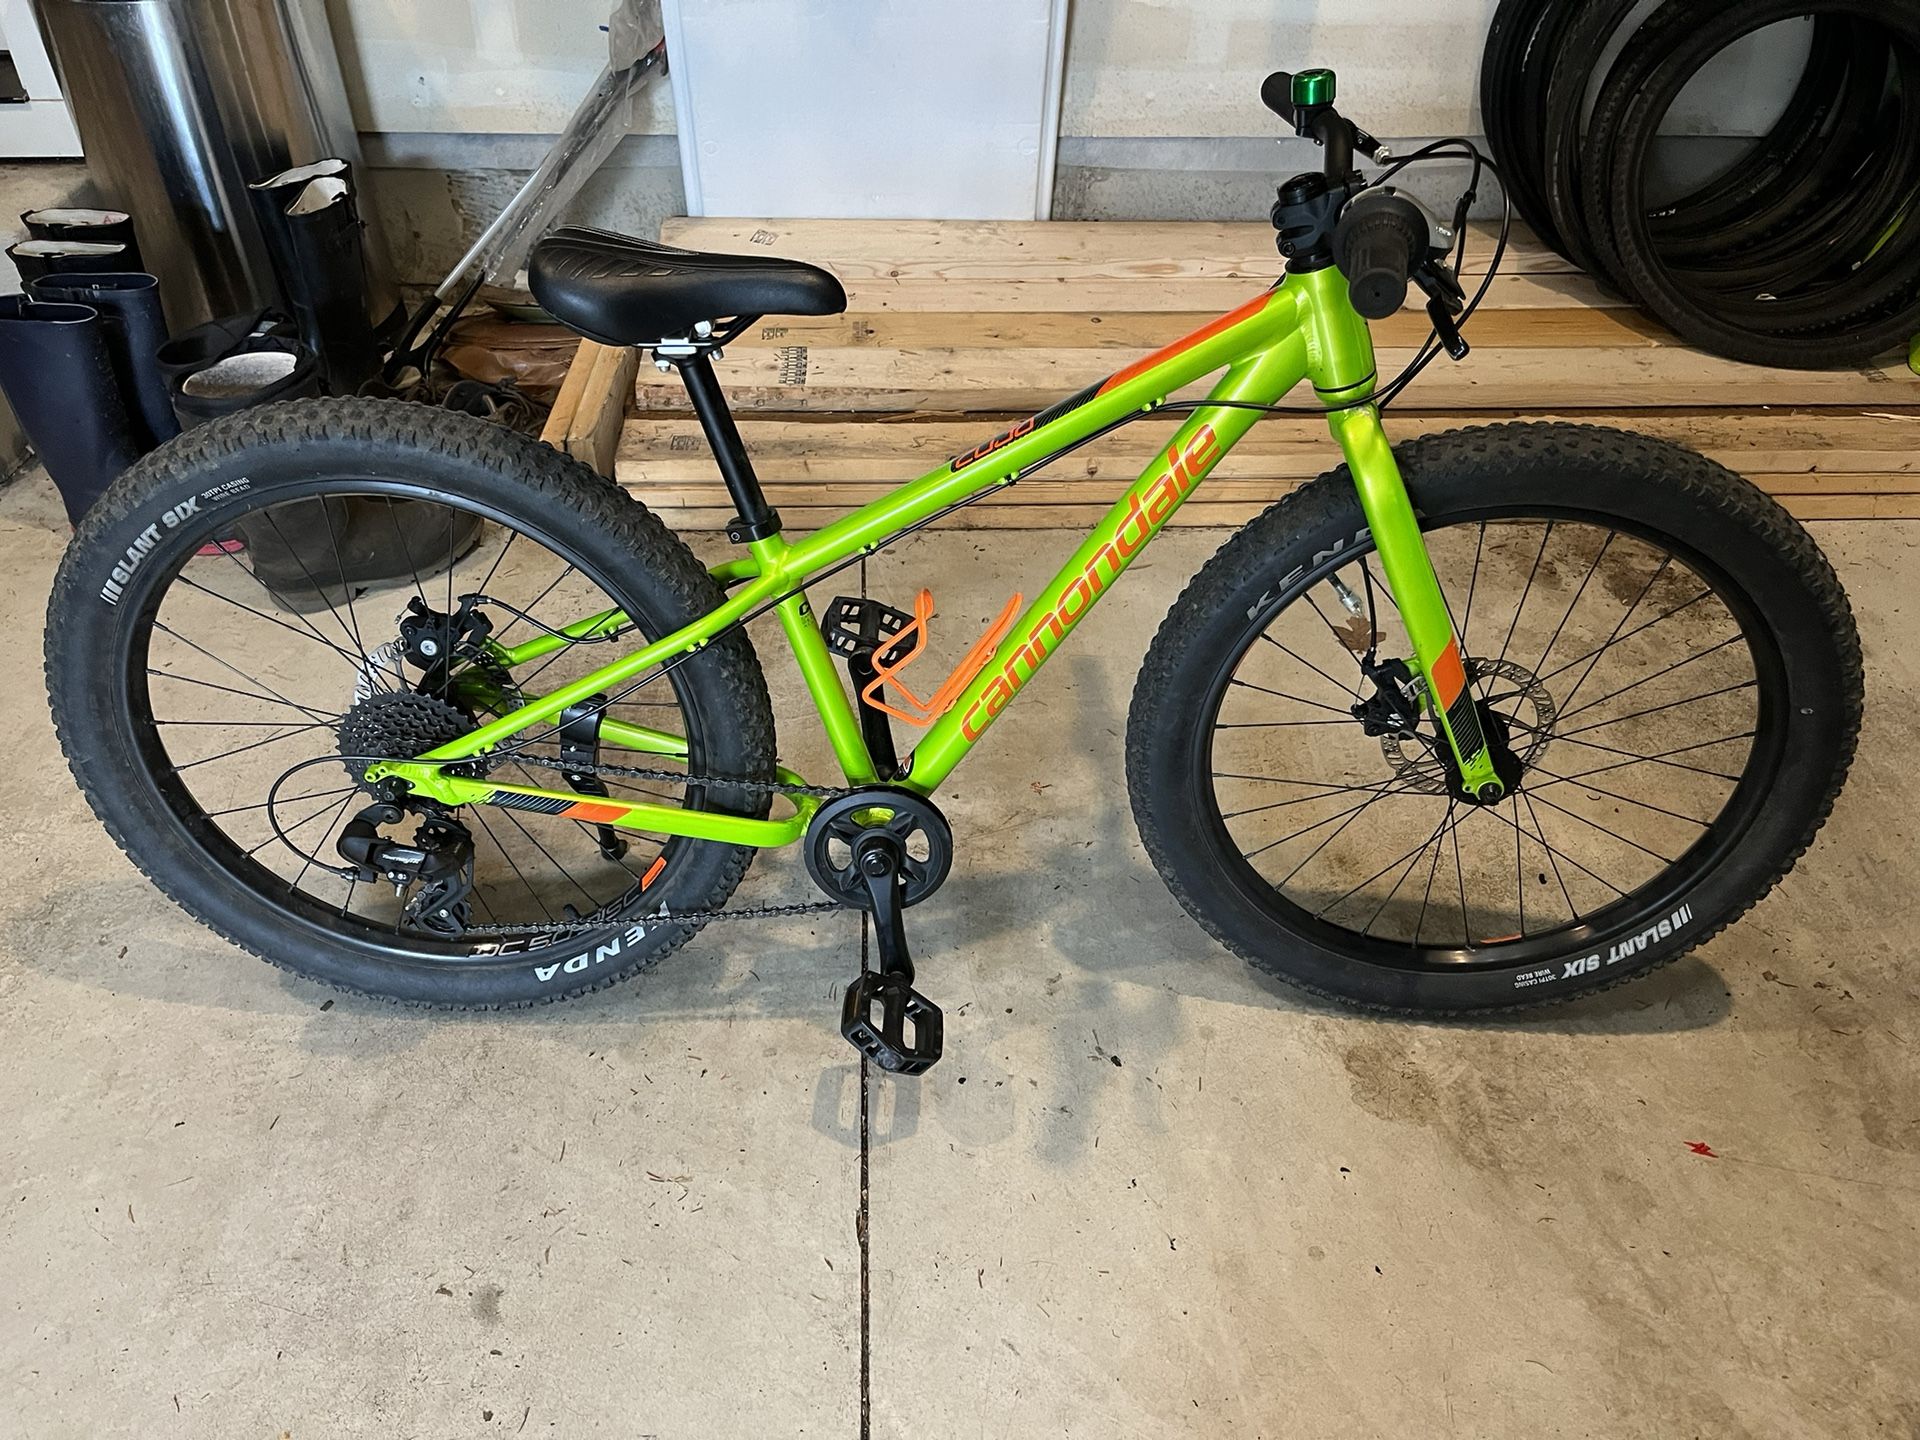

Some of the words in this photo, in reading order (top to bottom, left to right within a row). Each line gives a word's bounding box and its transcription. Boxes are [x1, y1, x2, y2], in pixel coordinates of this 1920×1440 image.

[220, 477, 250, 491] CASING
[161, 495, 202, 528] SIX
[961, 424, 1221, 743] cannondale
[1246, 526, 1371, 621] KEN
[1515, 971, 1535, 982] BEAD
[1533, 968, 1552, 978] WIRE
[1561, 953, 1600, 980] SIX
[1513, 977, 1539, 989] CASING
